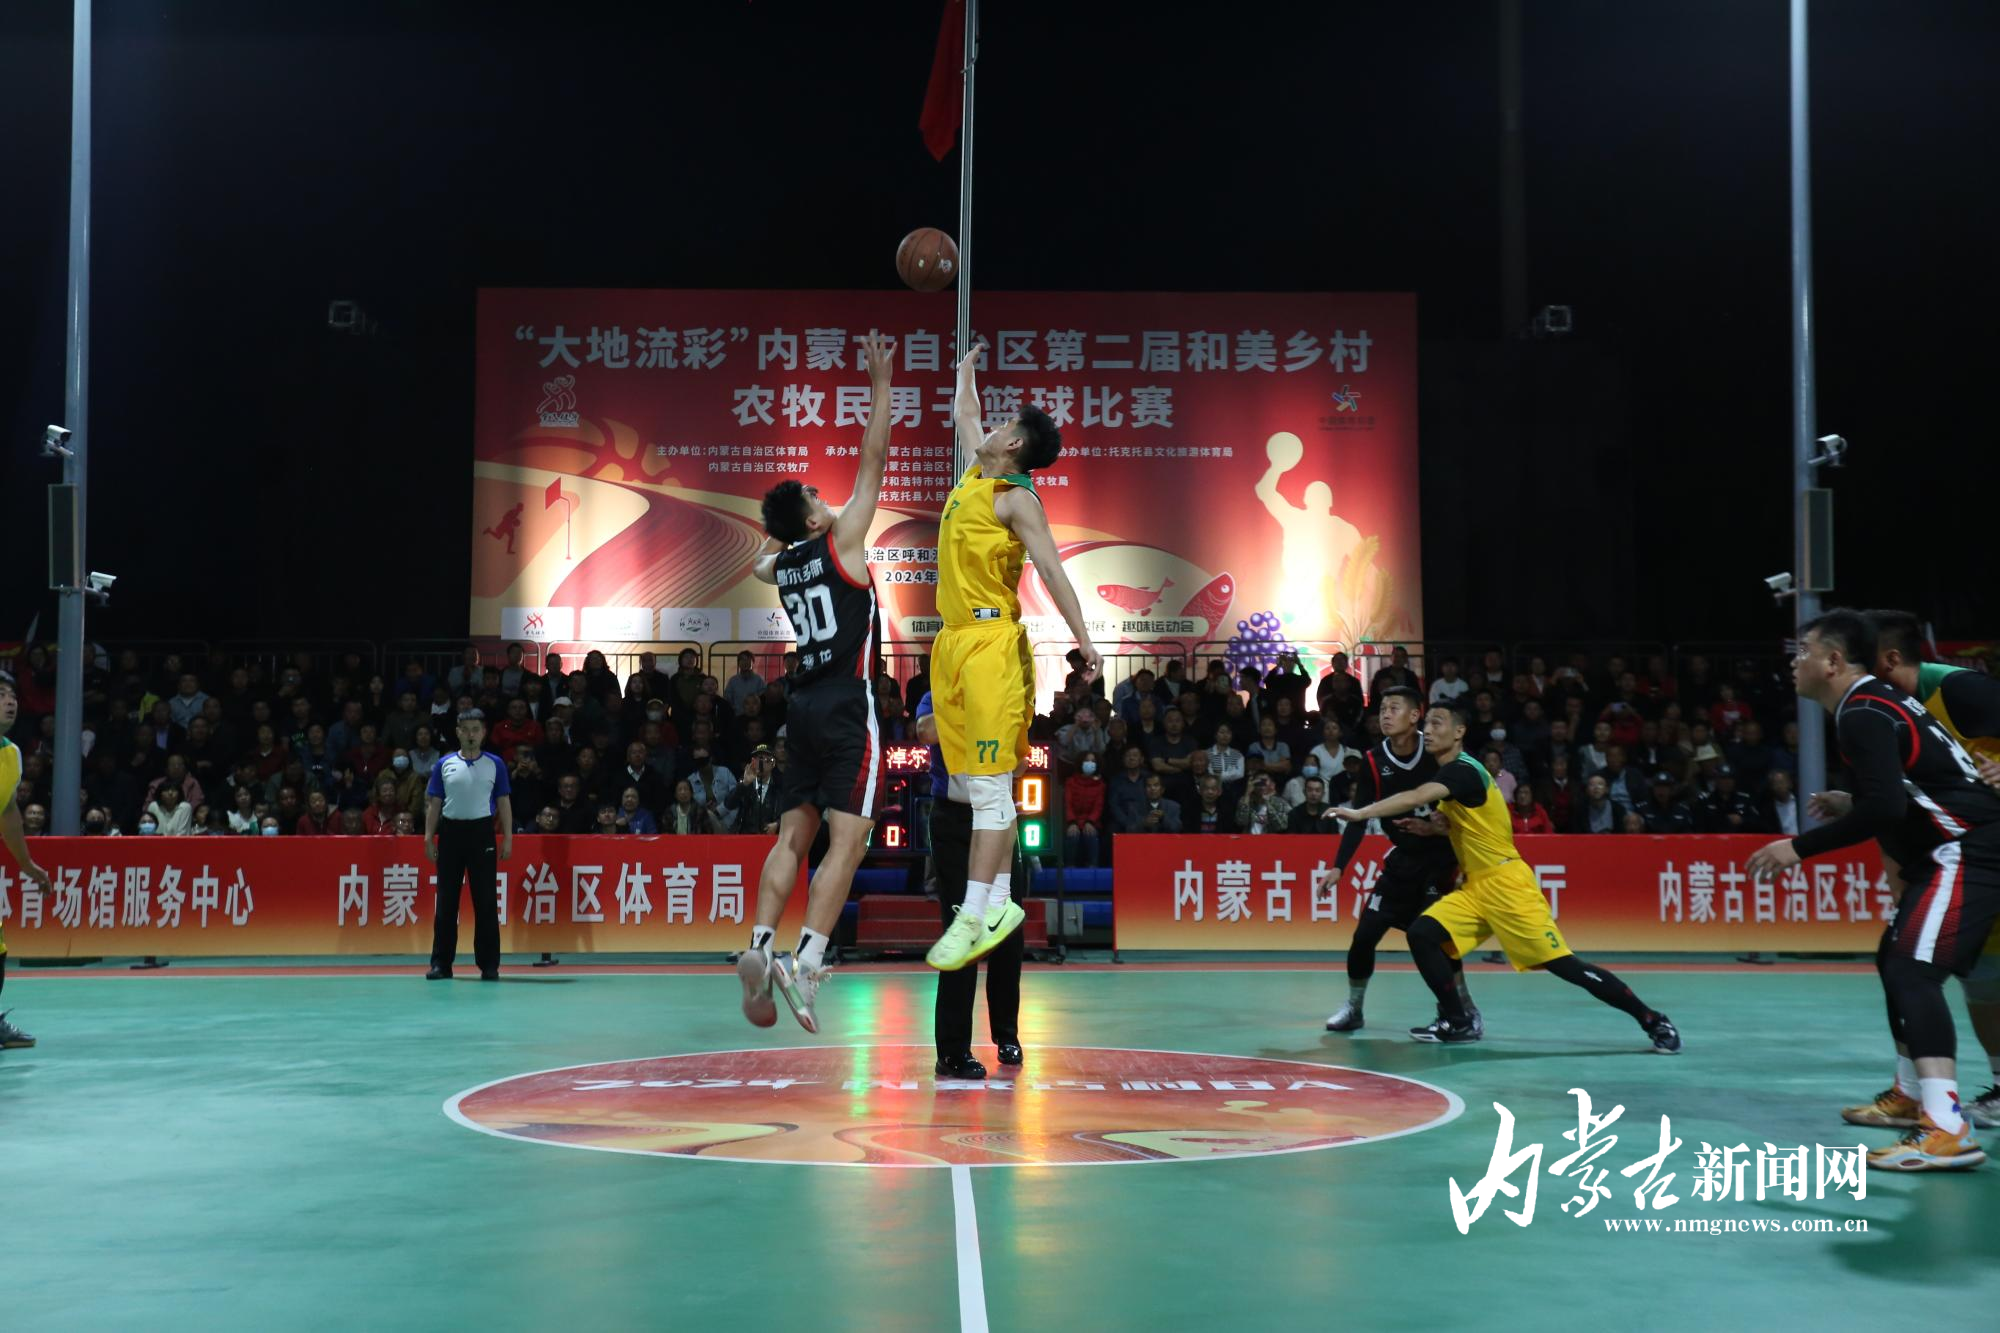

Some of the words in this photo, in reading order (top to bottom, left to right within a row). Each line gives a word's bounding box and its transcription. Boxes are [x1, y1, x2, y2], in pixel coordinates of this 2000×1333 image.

[825, 445, 863, 457] 承办单
[708, 461, 810, 473] 内蒙古自治区农牧厅
[884, 461, 953, 472] 蒙古自治区
[1031, 475, 1070, 487] 农牧局
[878, 490, 951, 502] 托克托县人民
[782, 583, 838, 648] 30
[976, 740, 999, 764] 77
[1022, 778, 1042, 811] 0
[886, 825, 899, 847] 0
[338, 862, 745, 928] 内蒙治区体育局
[1545, 931, 1560, 950] 3
